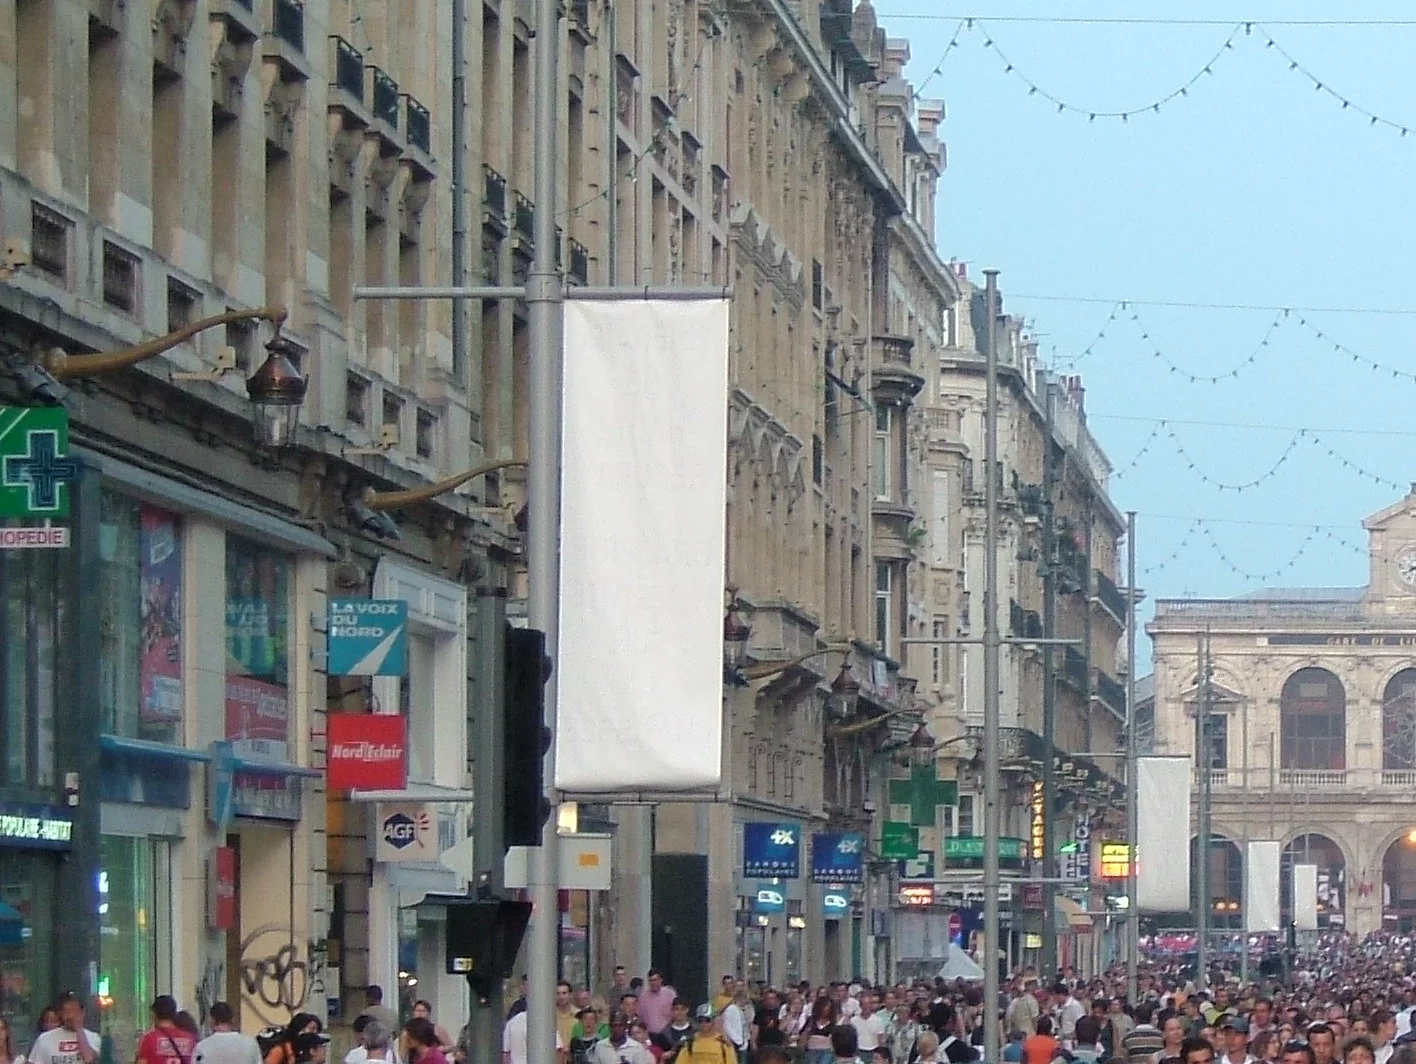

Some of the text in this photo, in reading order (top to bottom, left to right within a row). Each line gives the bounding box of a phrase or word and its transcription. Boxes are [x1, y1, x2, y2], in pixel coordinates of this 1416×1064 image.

[331, 602, 398, 615] LA VOIX
[332, 615, 357, 626] DU
[332, 627, 385, 638] NORD
[384, 822, 417, 840] AGF
